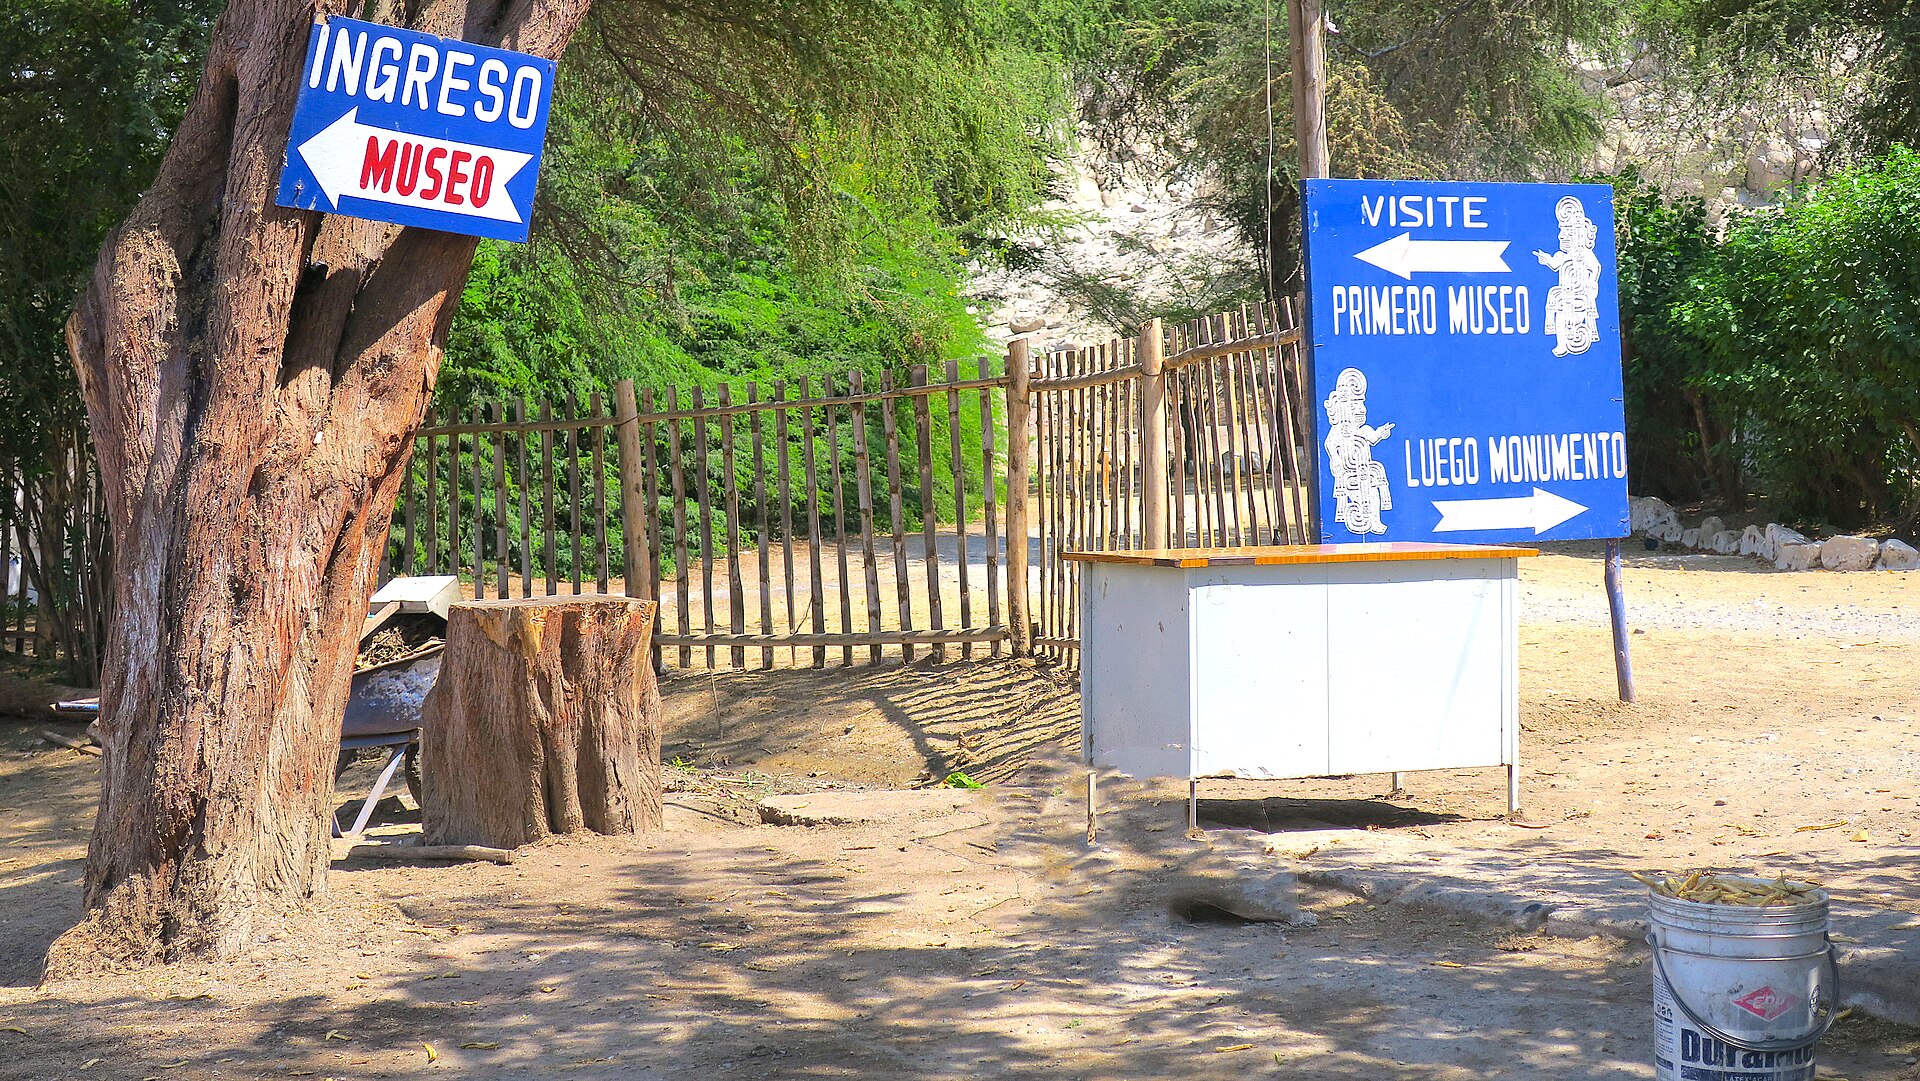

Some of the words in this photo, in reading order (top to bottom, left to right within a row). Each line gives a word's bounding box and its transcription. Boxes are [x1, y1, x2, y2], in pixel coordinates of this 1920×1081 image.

[308, 23, 542, 130] INGRESO
[359, 135, 495, 209] MUSEO
[1362, 195, 1489, 229] VISITE
[1332, 285, 1438, 336] PRIMERO
[1448, 285, 1530, 335] MUSEO
[1405, 437, 1479, 488] LUEGO
[1488, 431, 1627, 485] MONUMENTO
